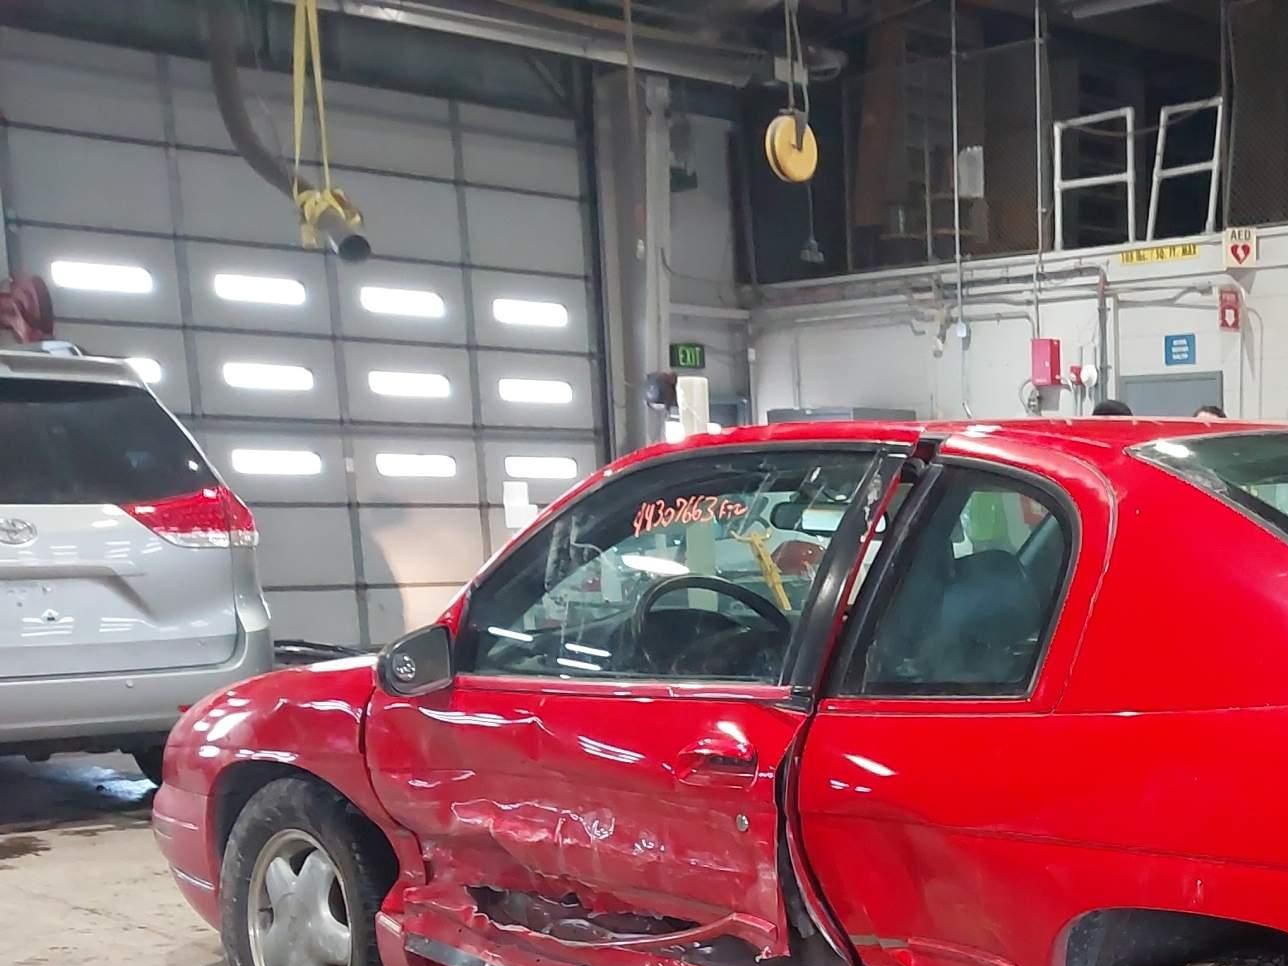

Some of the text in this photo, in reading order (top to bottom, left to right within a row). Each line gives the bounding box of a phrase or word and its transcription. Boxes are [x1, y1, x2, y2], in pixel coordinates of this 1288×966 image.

[1231, 230, 1251, 241] AED
[679, 346, 701, 366] EXIT
[633, 495, 718, 538] 44307663
